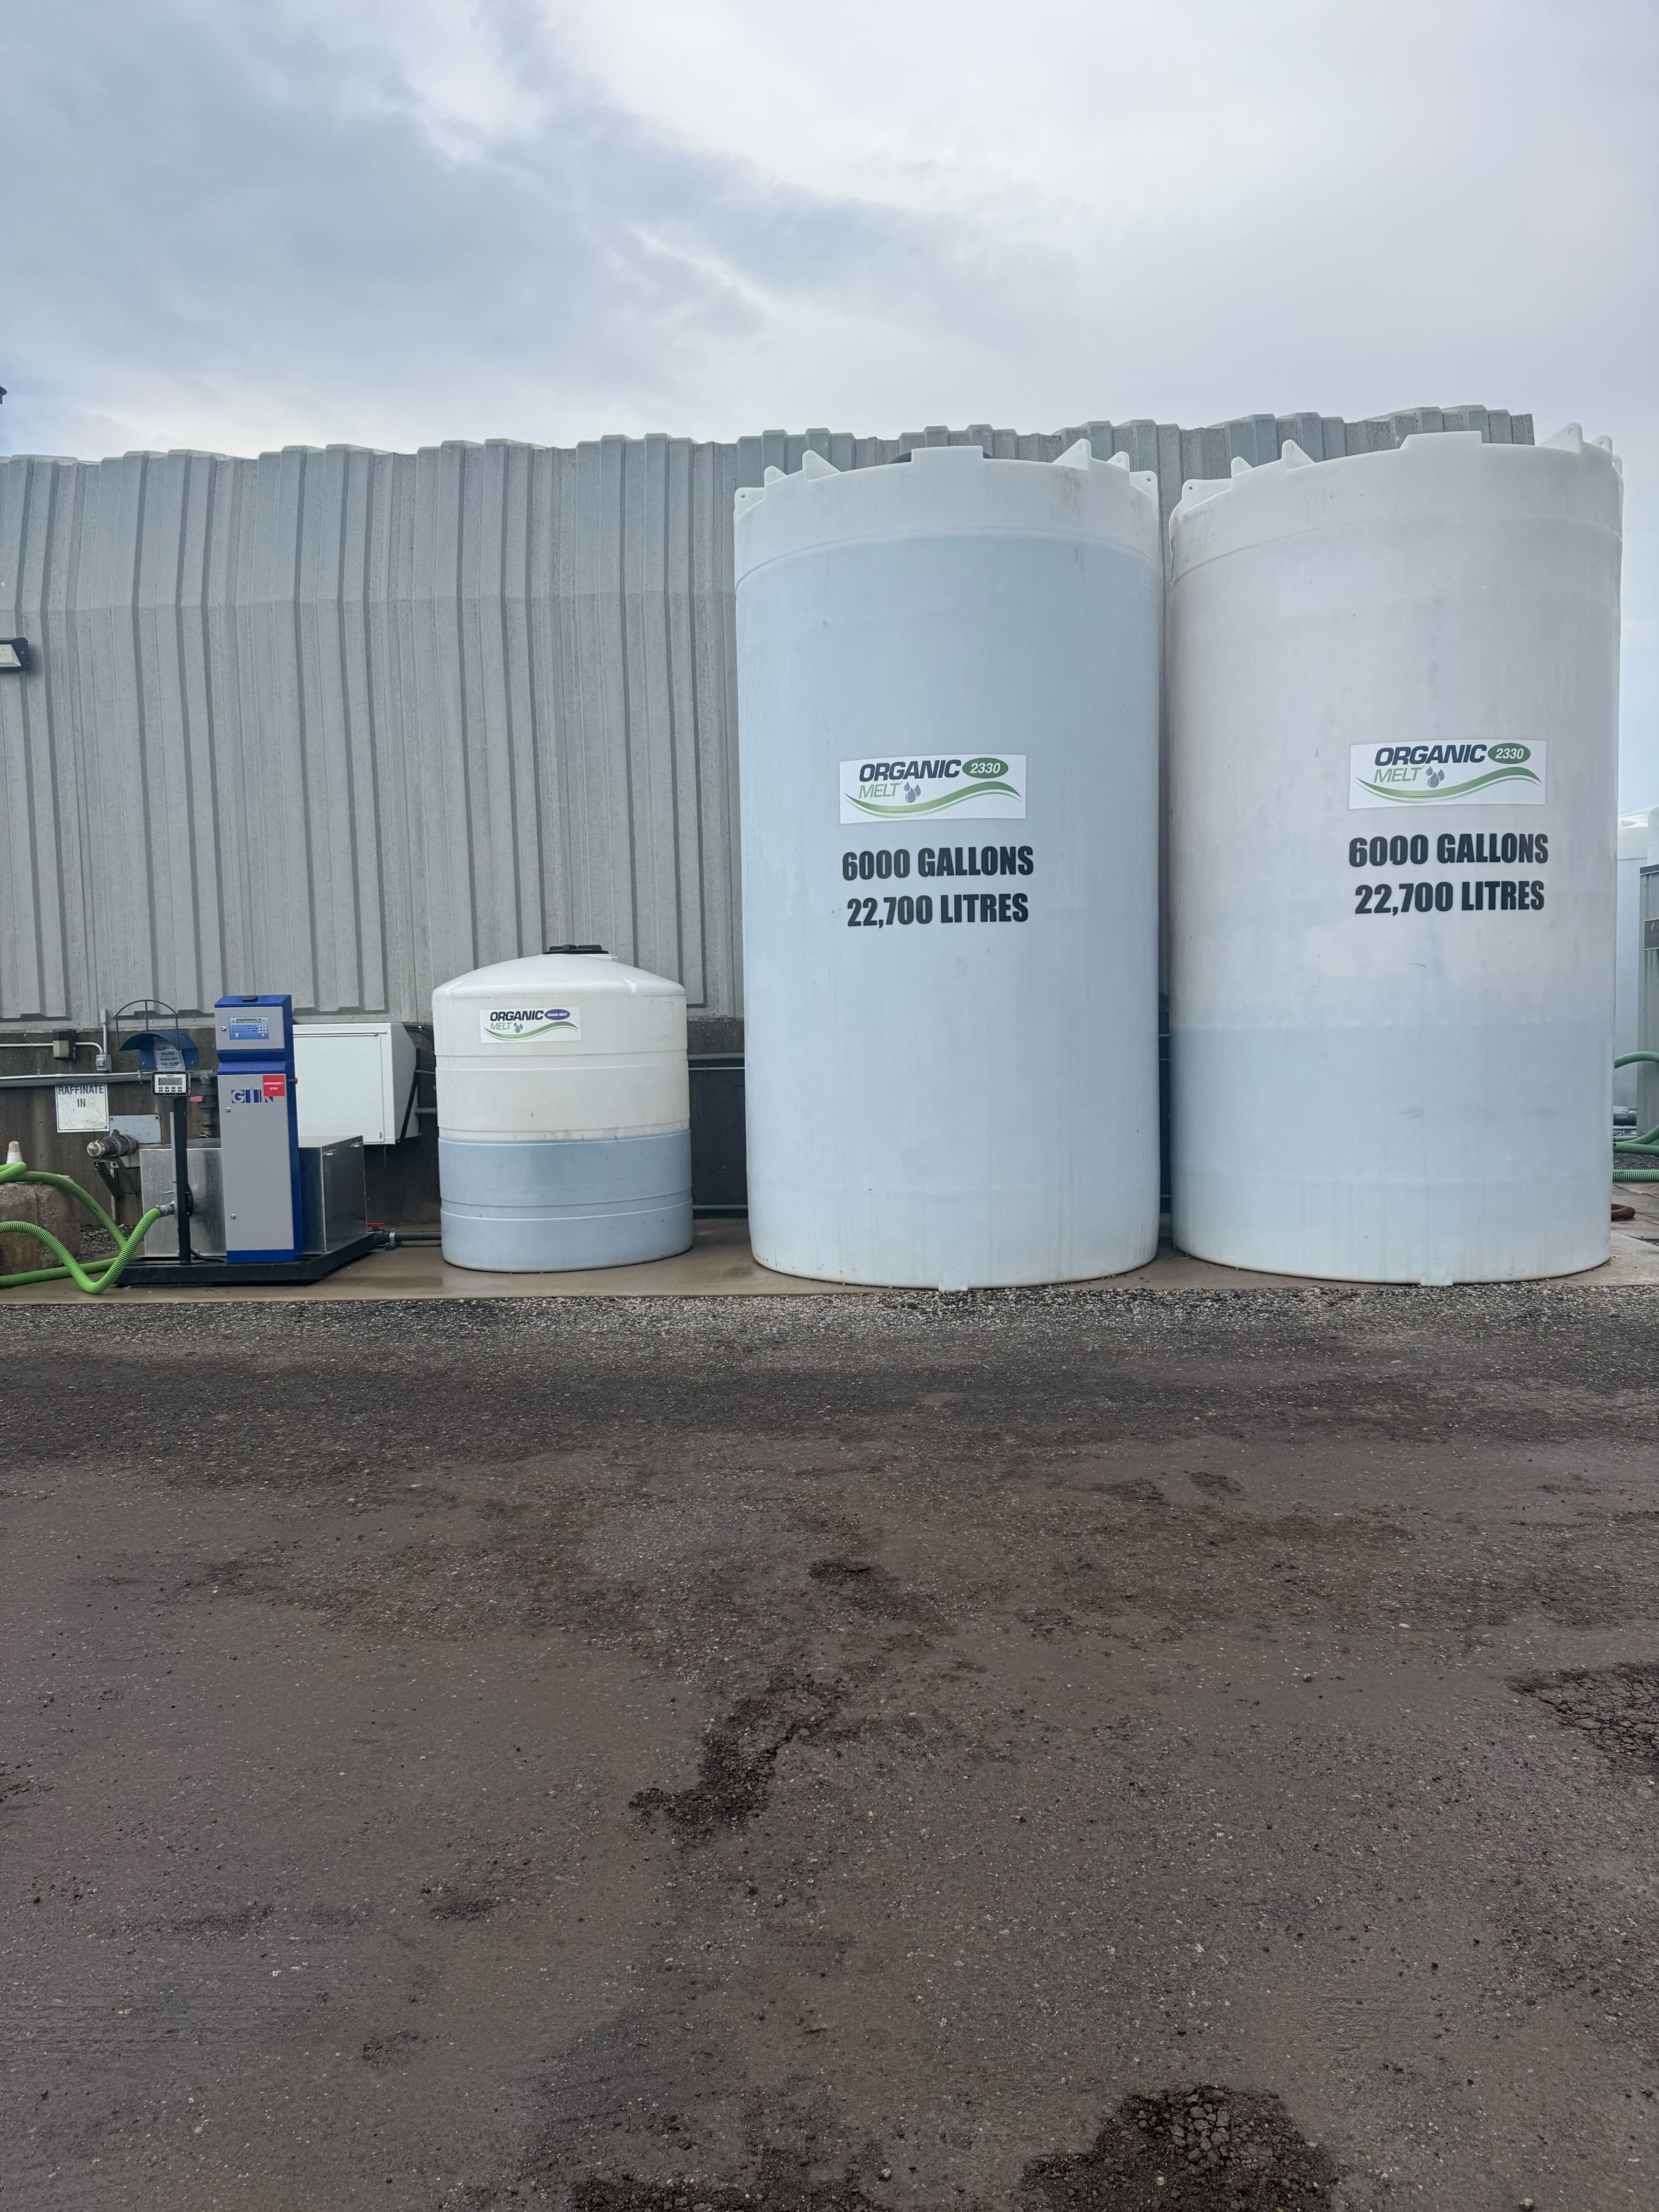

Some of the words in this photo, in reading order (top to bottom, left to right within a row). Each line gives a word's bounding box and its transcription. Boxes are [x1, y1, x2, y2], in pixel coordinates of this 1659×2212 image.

[1374, 744, 1487, 766] ORGANIC
[1495, 748, 1524, 759] 2330
[859, 759, 961, 782] ORGANIC
[969, 763, 1001, 774] 2330
[1373, 767, 1420, 783] MELT
[859, 783, 898, 799] MELT
[1349, 834, 1428, 867] 6000
[1437, 833, 1549, 864] GALLONS
[842, 848, 911, 881] 6000
[918, 846, 1034, 877] GALLONS
[1354, 881, 1453, 916] 22,700
[1461, 880, 1545, 911] LITRES
[847, 895, 933, 928] 22,700
[941, 893, 1029, 923] LITRES
[490, 1010, 544, 1022] ORGANIC
[490, 1022, 512, 1030] MELT
[58, 1084, 104, 1095] RAFFINATE
[77, 1098, 86, 1108] IN
